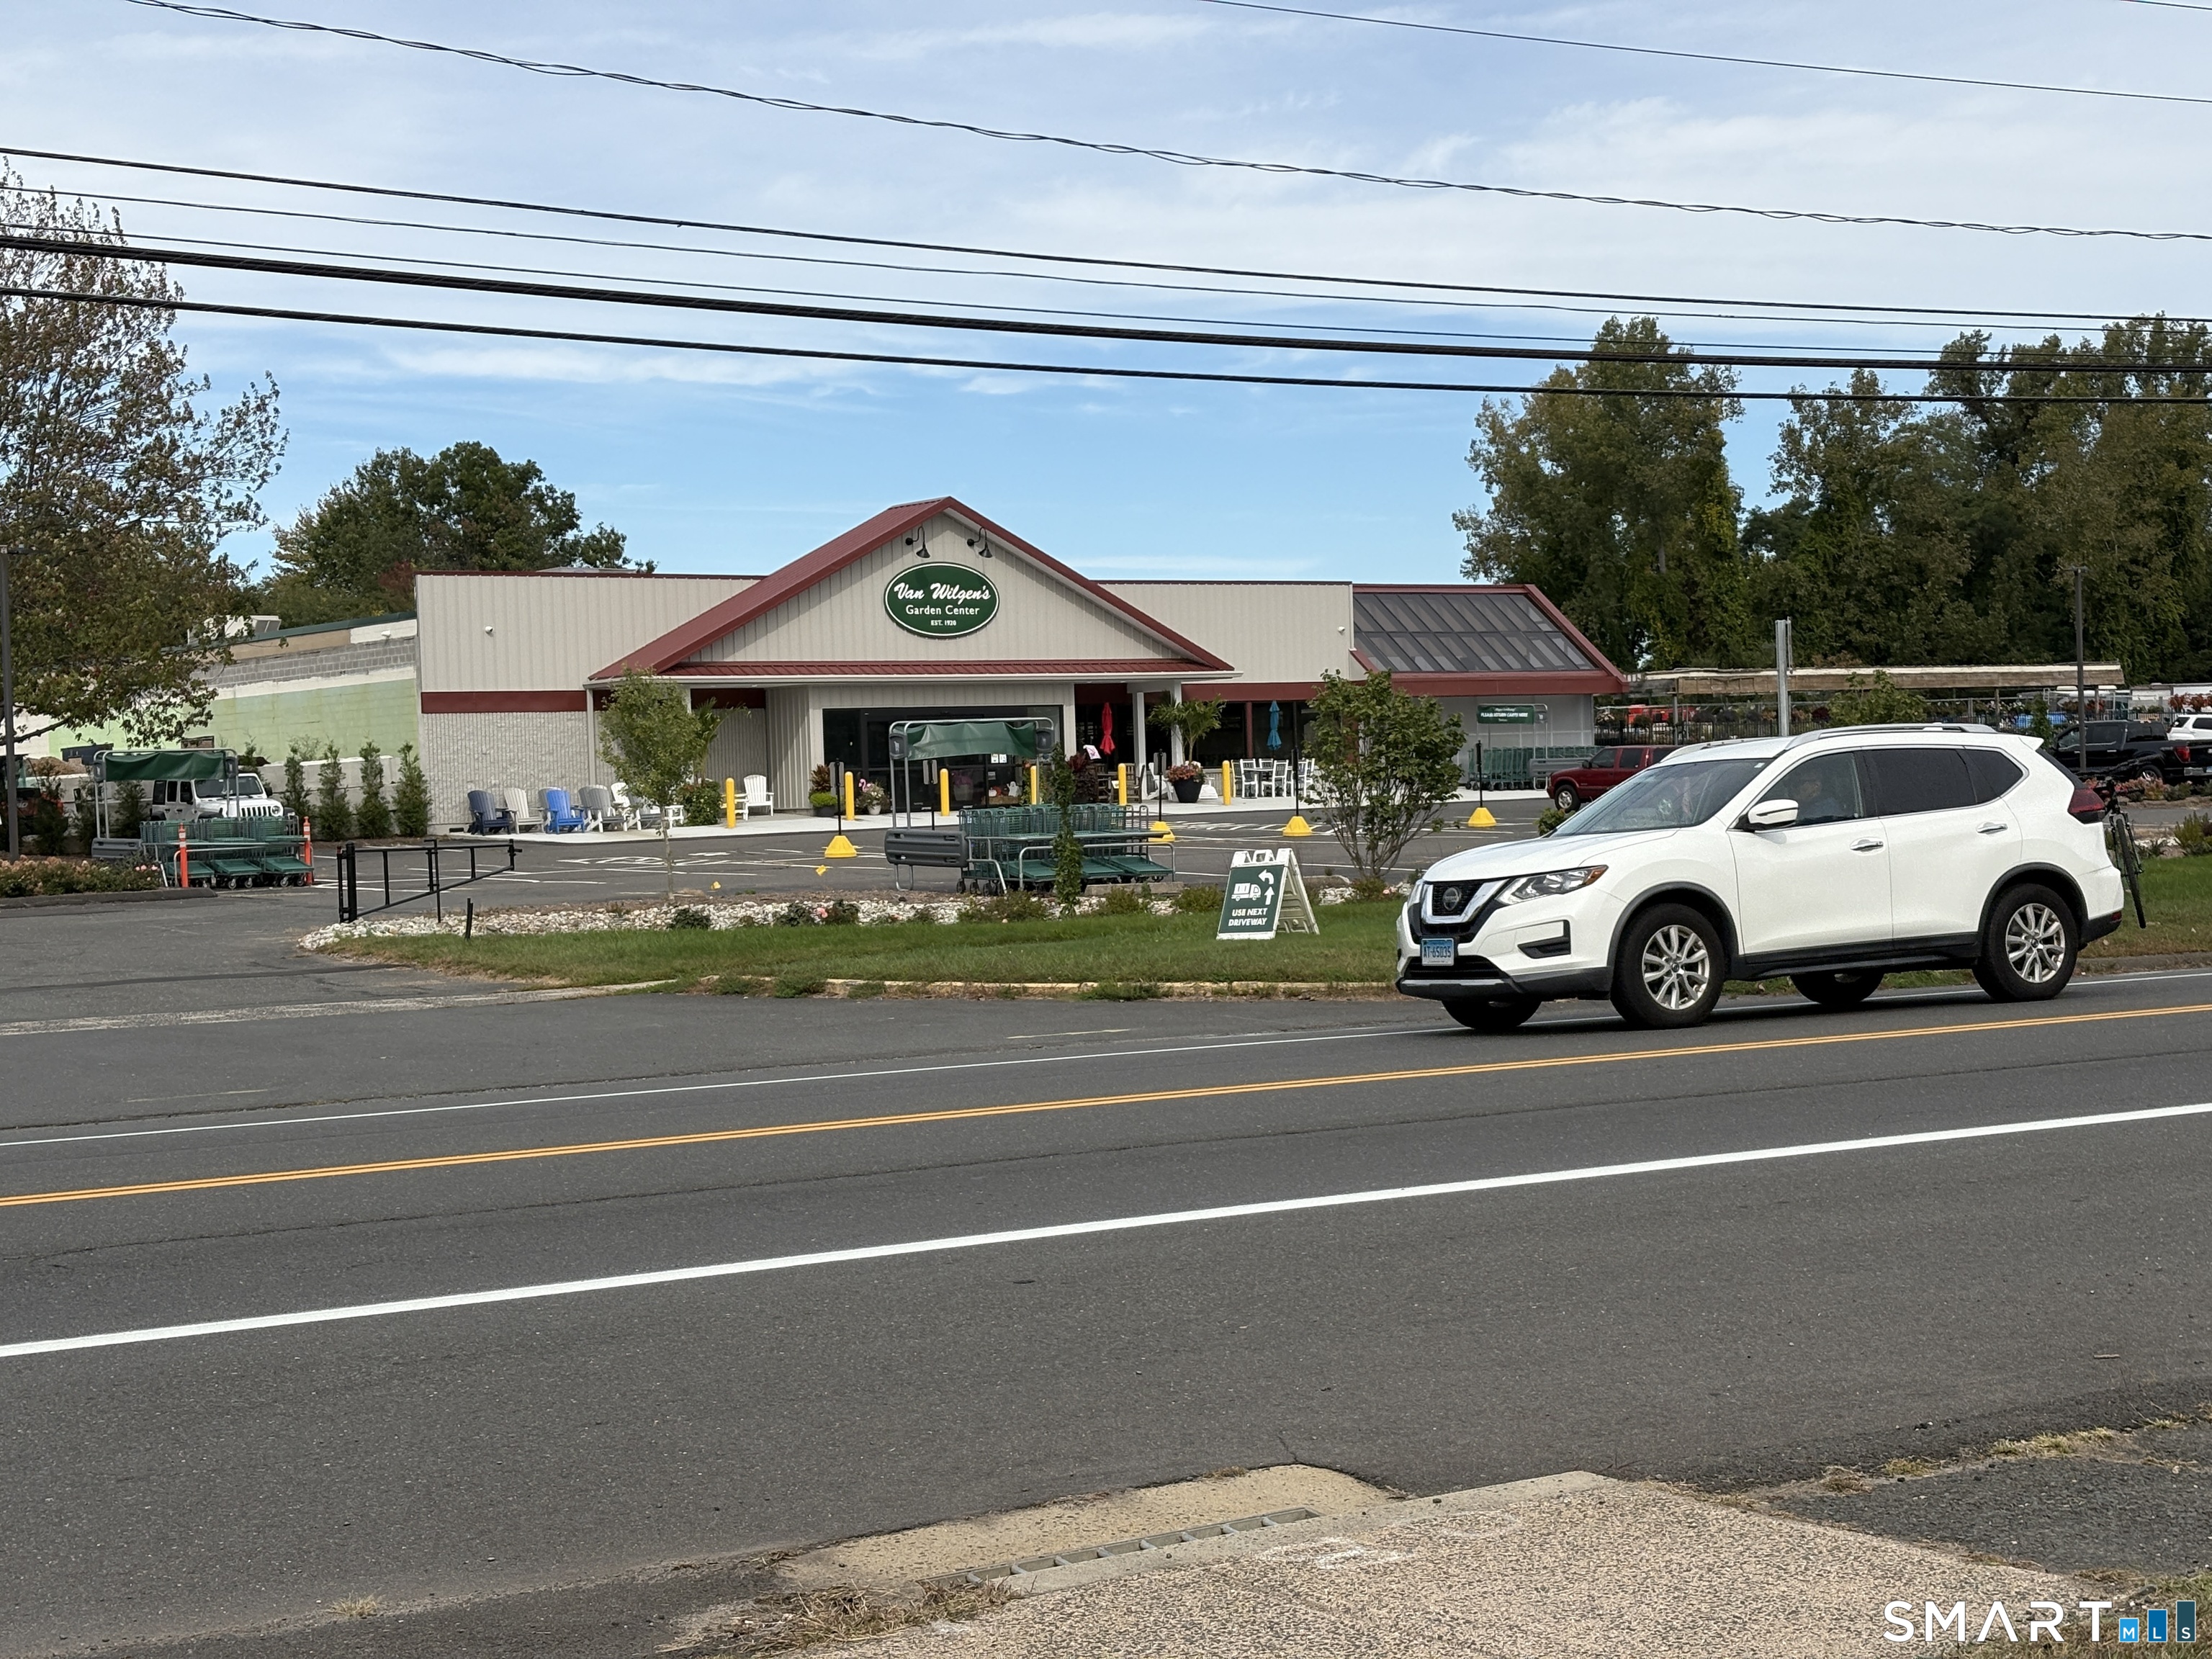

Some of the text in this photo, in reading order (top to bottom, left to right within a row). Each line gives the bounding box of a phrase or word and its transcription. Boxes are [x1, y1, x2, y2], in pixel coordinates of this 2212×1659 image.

[894, 583, 992, 605] Van Wilgen's
[905, 605, 980, 615] Garden Center
[1228, 917, 1268, 927] DRIVEWAY
